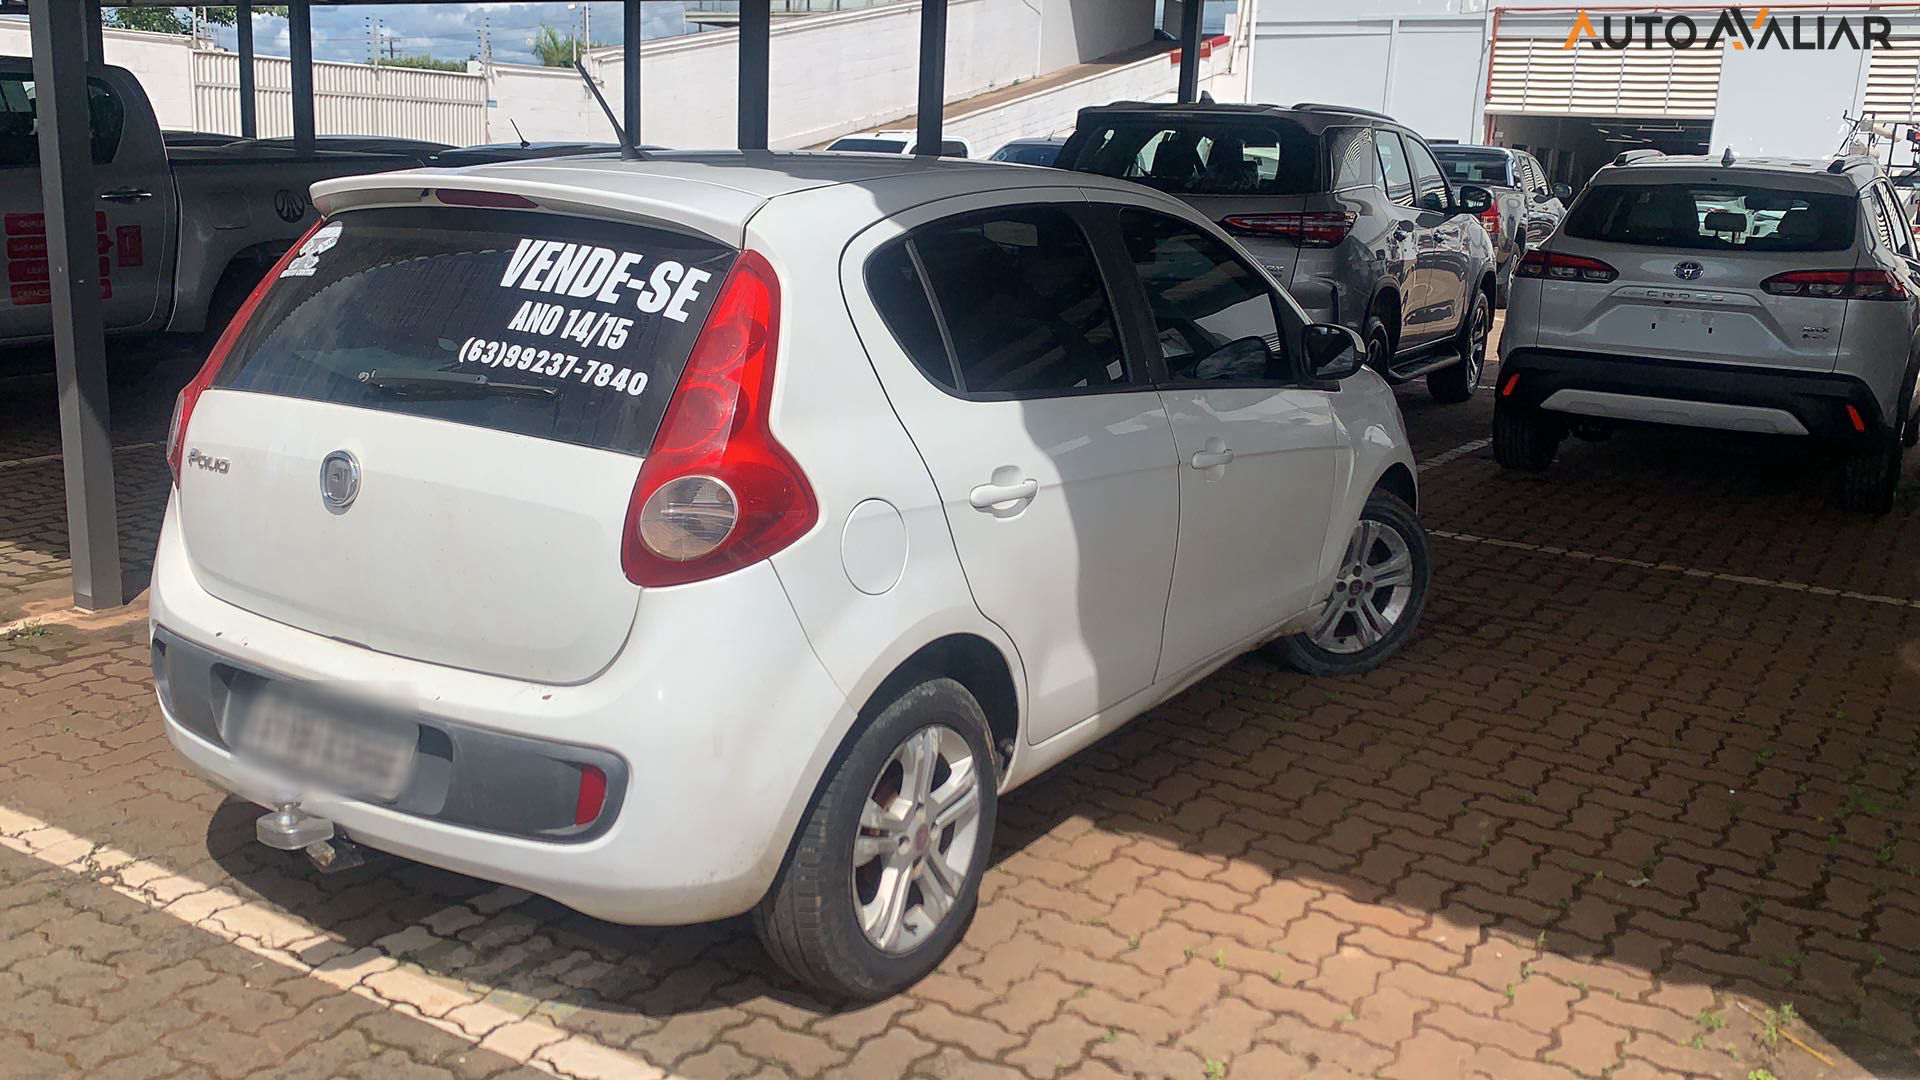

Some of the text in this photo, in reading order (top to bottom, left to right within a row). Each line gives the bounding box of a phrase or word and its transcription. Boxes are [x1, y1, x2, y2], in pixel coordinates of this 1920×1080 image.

[500, 238, 712, 323] VENDE-SE
[507, 300, 634, 350] ANO 14/15
[458, 336, 649, 396] (63)99237-7840
